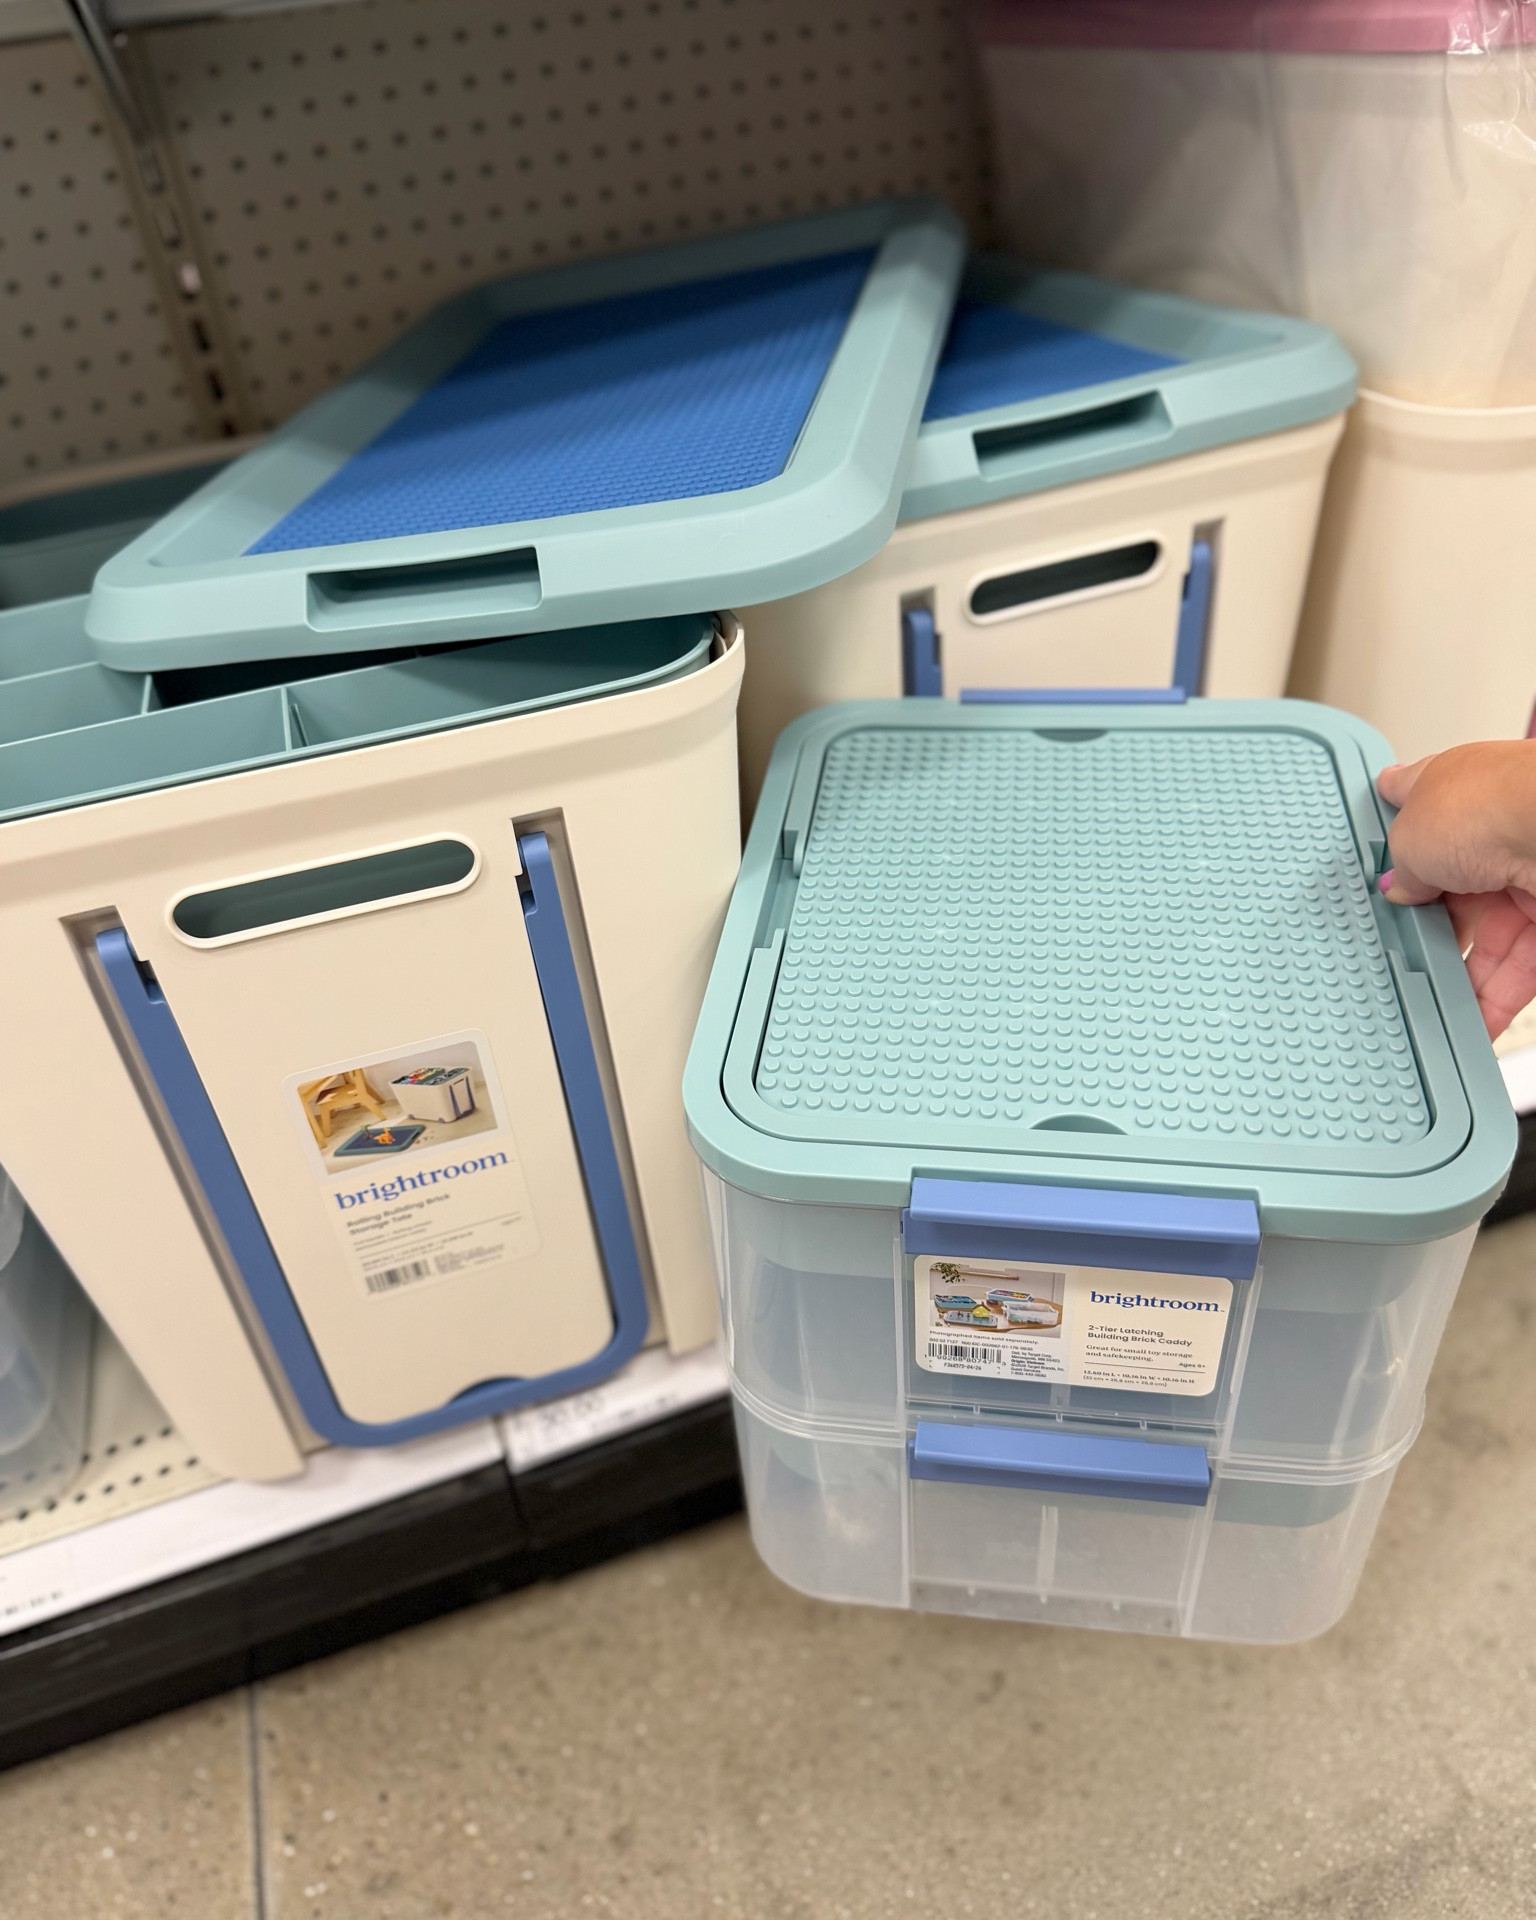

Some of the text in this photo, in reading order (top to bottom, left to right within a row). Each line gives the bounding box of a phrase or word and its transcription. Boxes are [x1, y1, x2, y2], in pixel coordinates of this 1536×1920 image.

[334, 1152, 508, 1210] brightroom
[1090, 1290, 1219, 1312] brightroom
[929, 1330, 972, 1338] Photographed
[1088, 1324, 1164, 1337] 2-Tier Latching
[1087, 1332, 1129, 1342] Building
[1158, 1338, 1192, 1347] Caddy
[1102, 1352, 1154, 1362] safekeeping.
